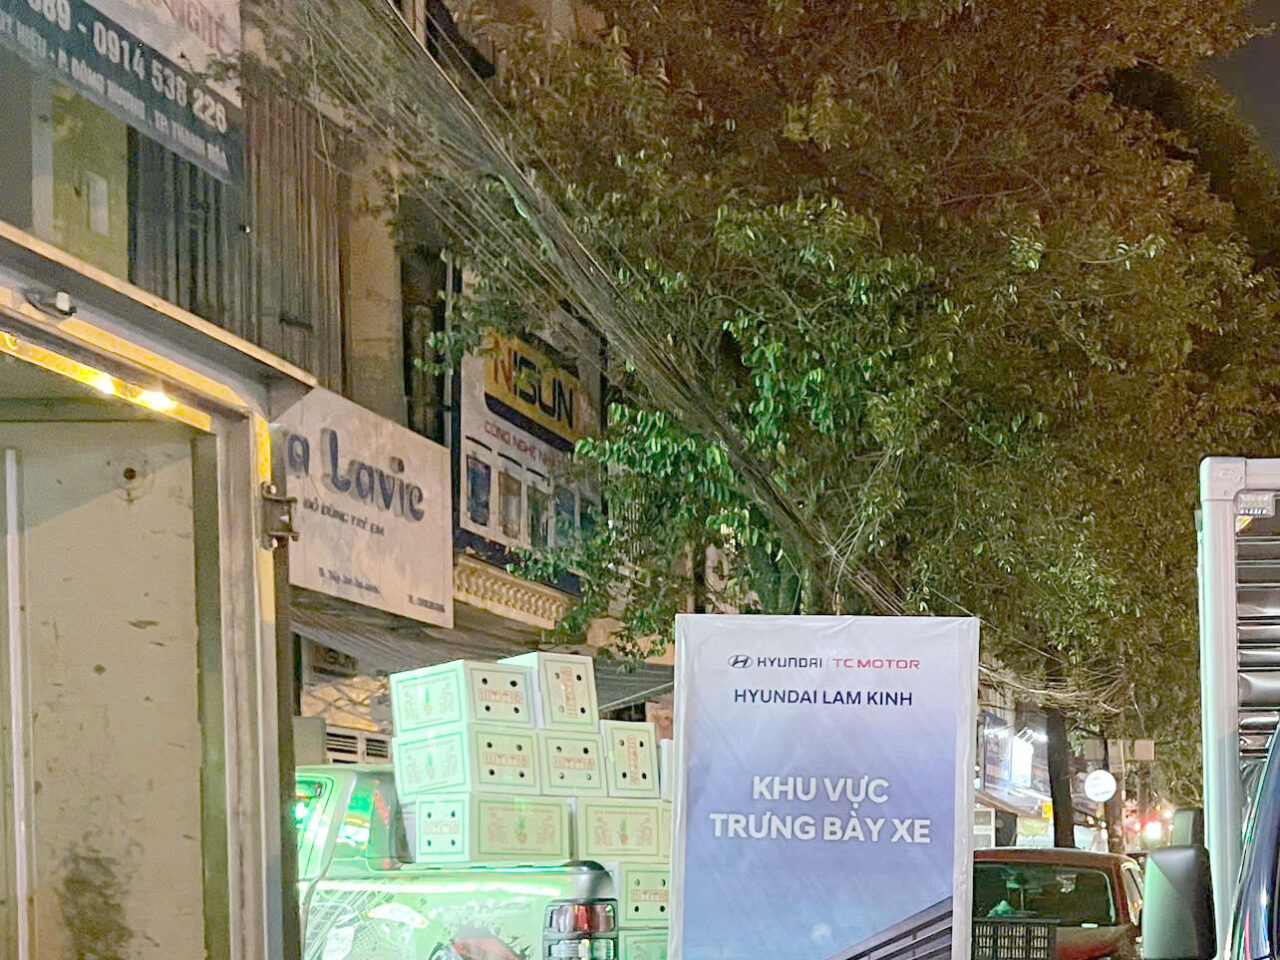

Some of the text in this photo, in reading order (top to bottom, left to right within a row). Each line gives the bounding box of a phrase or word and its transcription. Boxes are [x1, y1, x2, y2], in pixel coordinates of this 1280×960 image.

[93, 21, 146, 80] 0914
[320, 427, 425, 523] Lavie
[757, 656, 823, 669] HYUNDAI
[734, 689, 913, 706] HYUNDAI LAM KINH
[752, 775, 889, 809] KHU VỰC
[709, 810, 931, 843] TRƯNG BÀY XE
